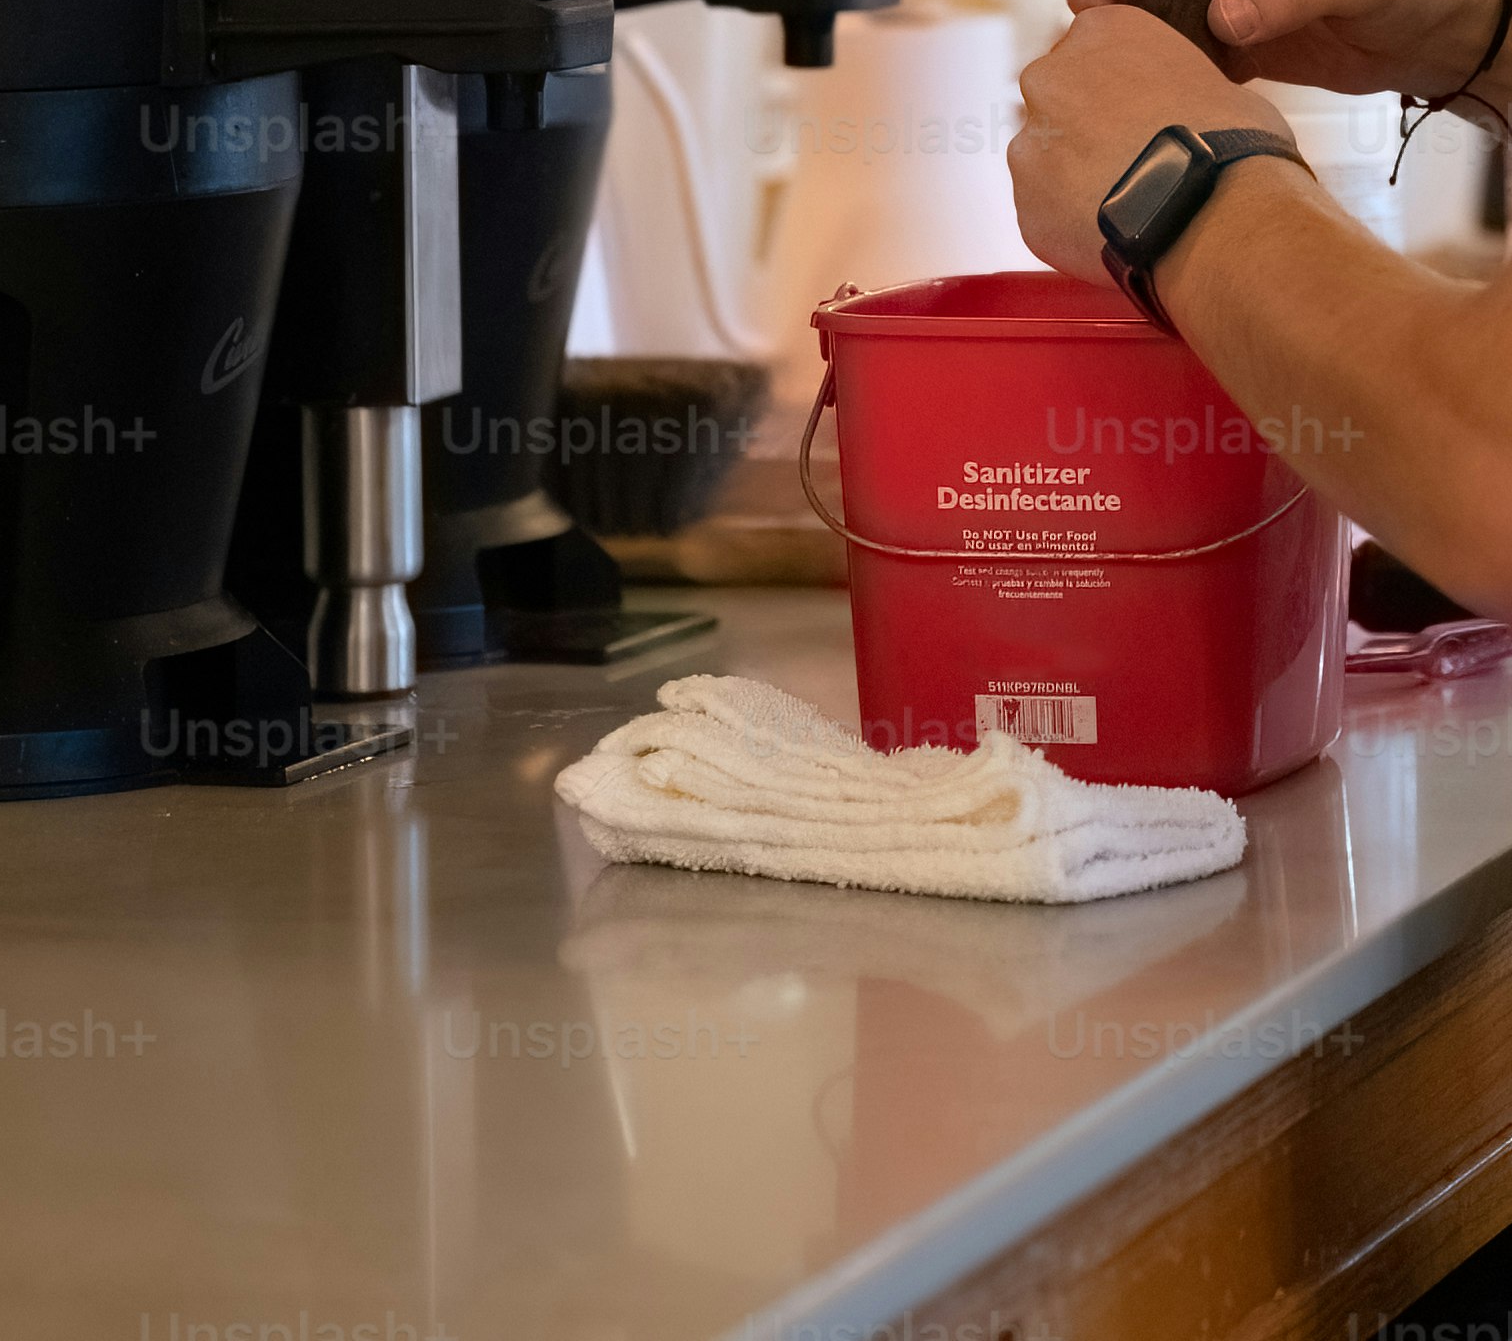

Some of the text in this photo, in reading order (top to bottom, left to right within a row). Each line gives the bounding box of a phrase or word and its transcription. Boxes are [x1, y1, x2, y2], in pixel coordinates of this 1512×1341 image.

[963, 461, 1090, 485] Sanitizer
[937, 486, 1121, 511] Desinfectante
[962, 529, 980, 540] Do
[983, 529, 1013, 540] NOT
[1042, 530, 1063, 541] For
[1066, 530, 1097, 541] Food
[965, 540, 984, 550] NO
[988, 541, 1013, 550] usar
[1017, 541, 1032, 550] en
